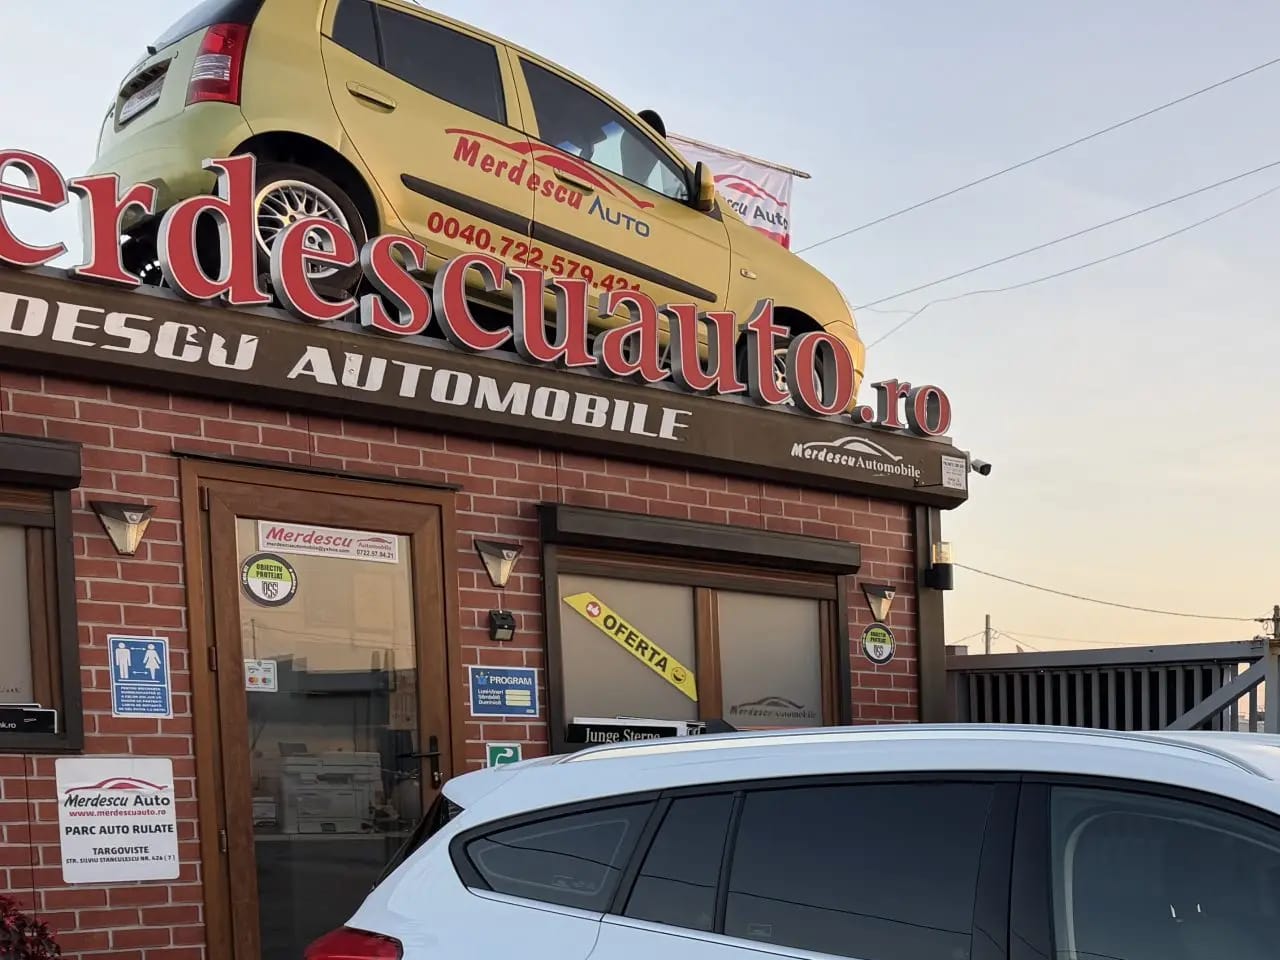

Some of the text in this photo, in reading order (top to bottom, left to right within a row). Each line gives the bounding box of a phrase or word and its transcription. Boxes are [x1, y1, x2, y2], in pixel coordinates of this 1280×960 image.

[453, 136, 650, 238] Merdescu AUTO
[287, 345, 692, 441] AUTOMOBILE
[266, 527, 353, 548] Merdescu
[603, 614, 668, 672] OFERTA
[489, 676, 532, 685] PROGRAM
[585, 727, 620, 746] Junge
[64, 794, 170, 807] Merdescu Auto
[69, 809, 166, 817] www.merdescuauto.ro
[65, 824, 174, 836] PARC AUTO RULATE
[92, 846, 150, 855] TARGOVISTE
